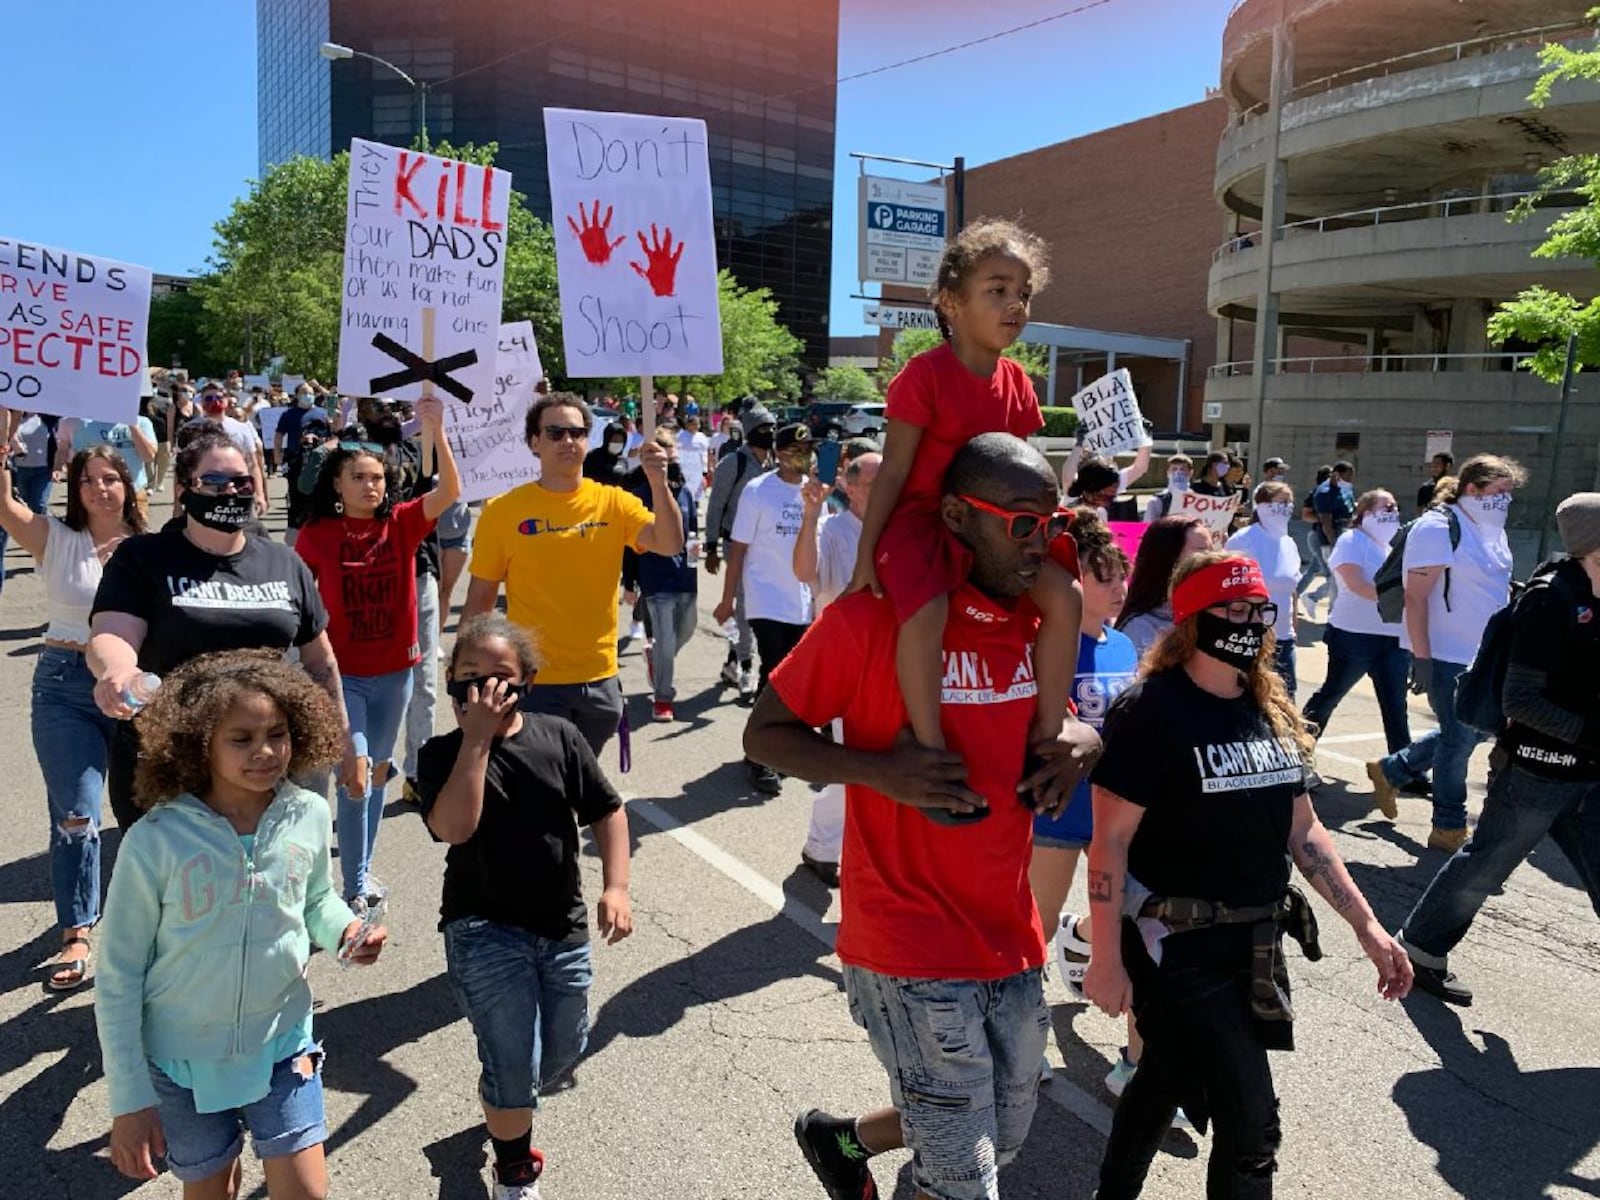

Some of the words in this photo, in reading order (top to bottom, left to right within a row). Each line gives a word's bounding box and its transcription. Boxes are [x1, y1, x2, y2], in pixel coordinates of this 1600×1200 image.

[568, 121, 705, 181] Don't
[354, 145, 388, 218] They
[896, 208, 939, 224] PARKING
[896, 220, 939, 236] GARAGE
[407, 220, 502, 268] DADS
[0, 273, 69, 302] RVE
[347, 250, 400, 278] then
[409, 262, 457, 285] make
[465, 269, 497, 295] fun
[382, 281, 399, 300] us
[411, 282, 434, 304] for
[442, 290, 474, 308] not
[8, 302, 48, 326] AS
[60, 309, 134, 342] SAFE
[347, 308, 409, 343] having
[452, 316, 489, 335] one
[576, 295, 704, 357] Shoot
[223, 580, 291, 601] BREATHE
[1193, 747, 1206, 778] I
[1208, 777, 1247, 790] BLACK
[1248, 773, 1276, 787] LIVES
